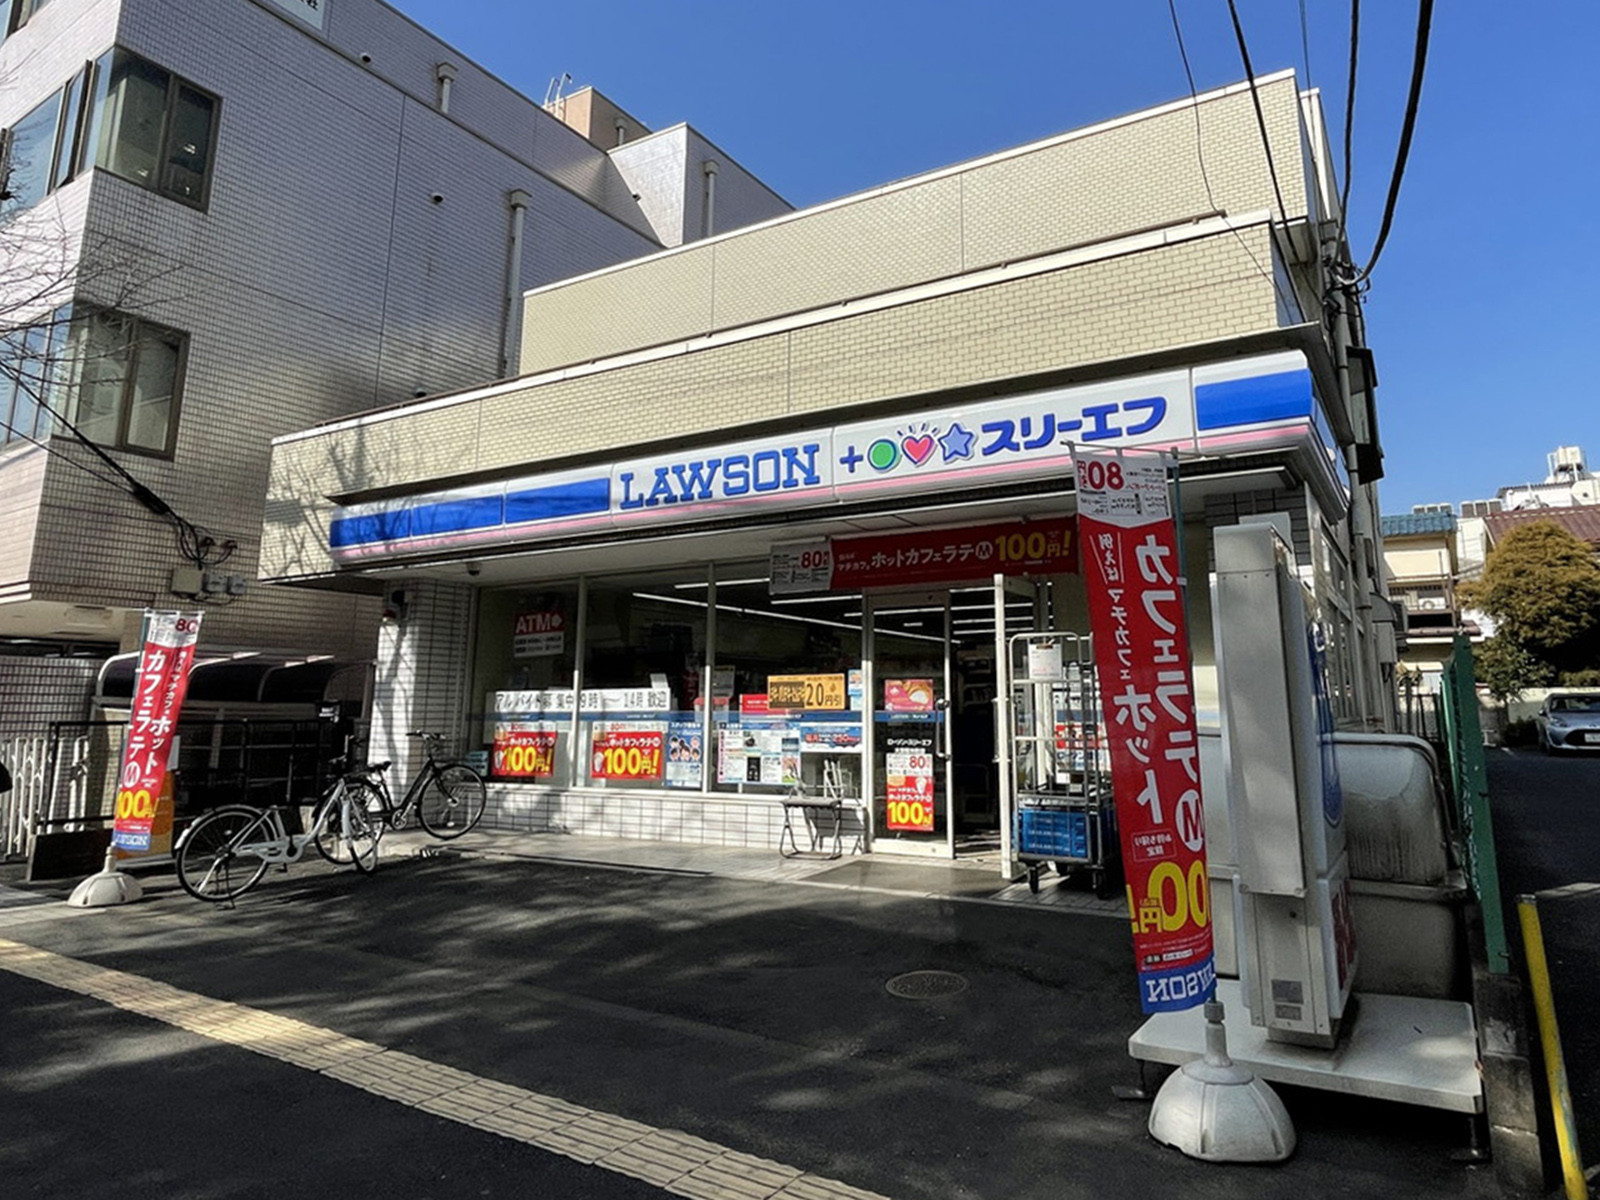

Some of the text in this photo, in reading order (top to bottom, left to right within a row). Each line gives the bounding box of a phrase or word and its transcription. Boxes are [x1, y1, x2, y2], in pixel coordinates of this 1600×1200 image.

[619, 444, 820, 510] LAWSON
[981, 396, 1167, 456] スリーエフ
[801, 551, 822, 569] 80
[870, 543, 975, 569] ホットカフェラテ
[515, 613, 551, 634] ATM
[130, 650, 165, 759] カフェラテ
[145, 716, 172, 775] ホット
[604, 747, 660, 775] 100円!
[909, 755, 926, 769] 80
